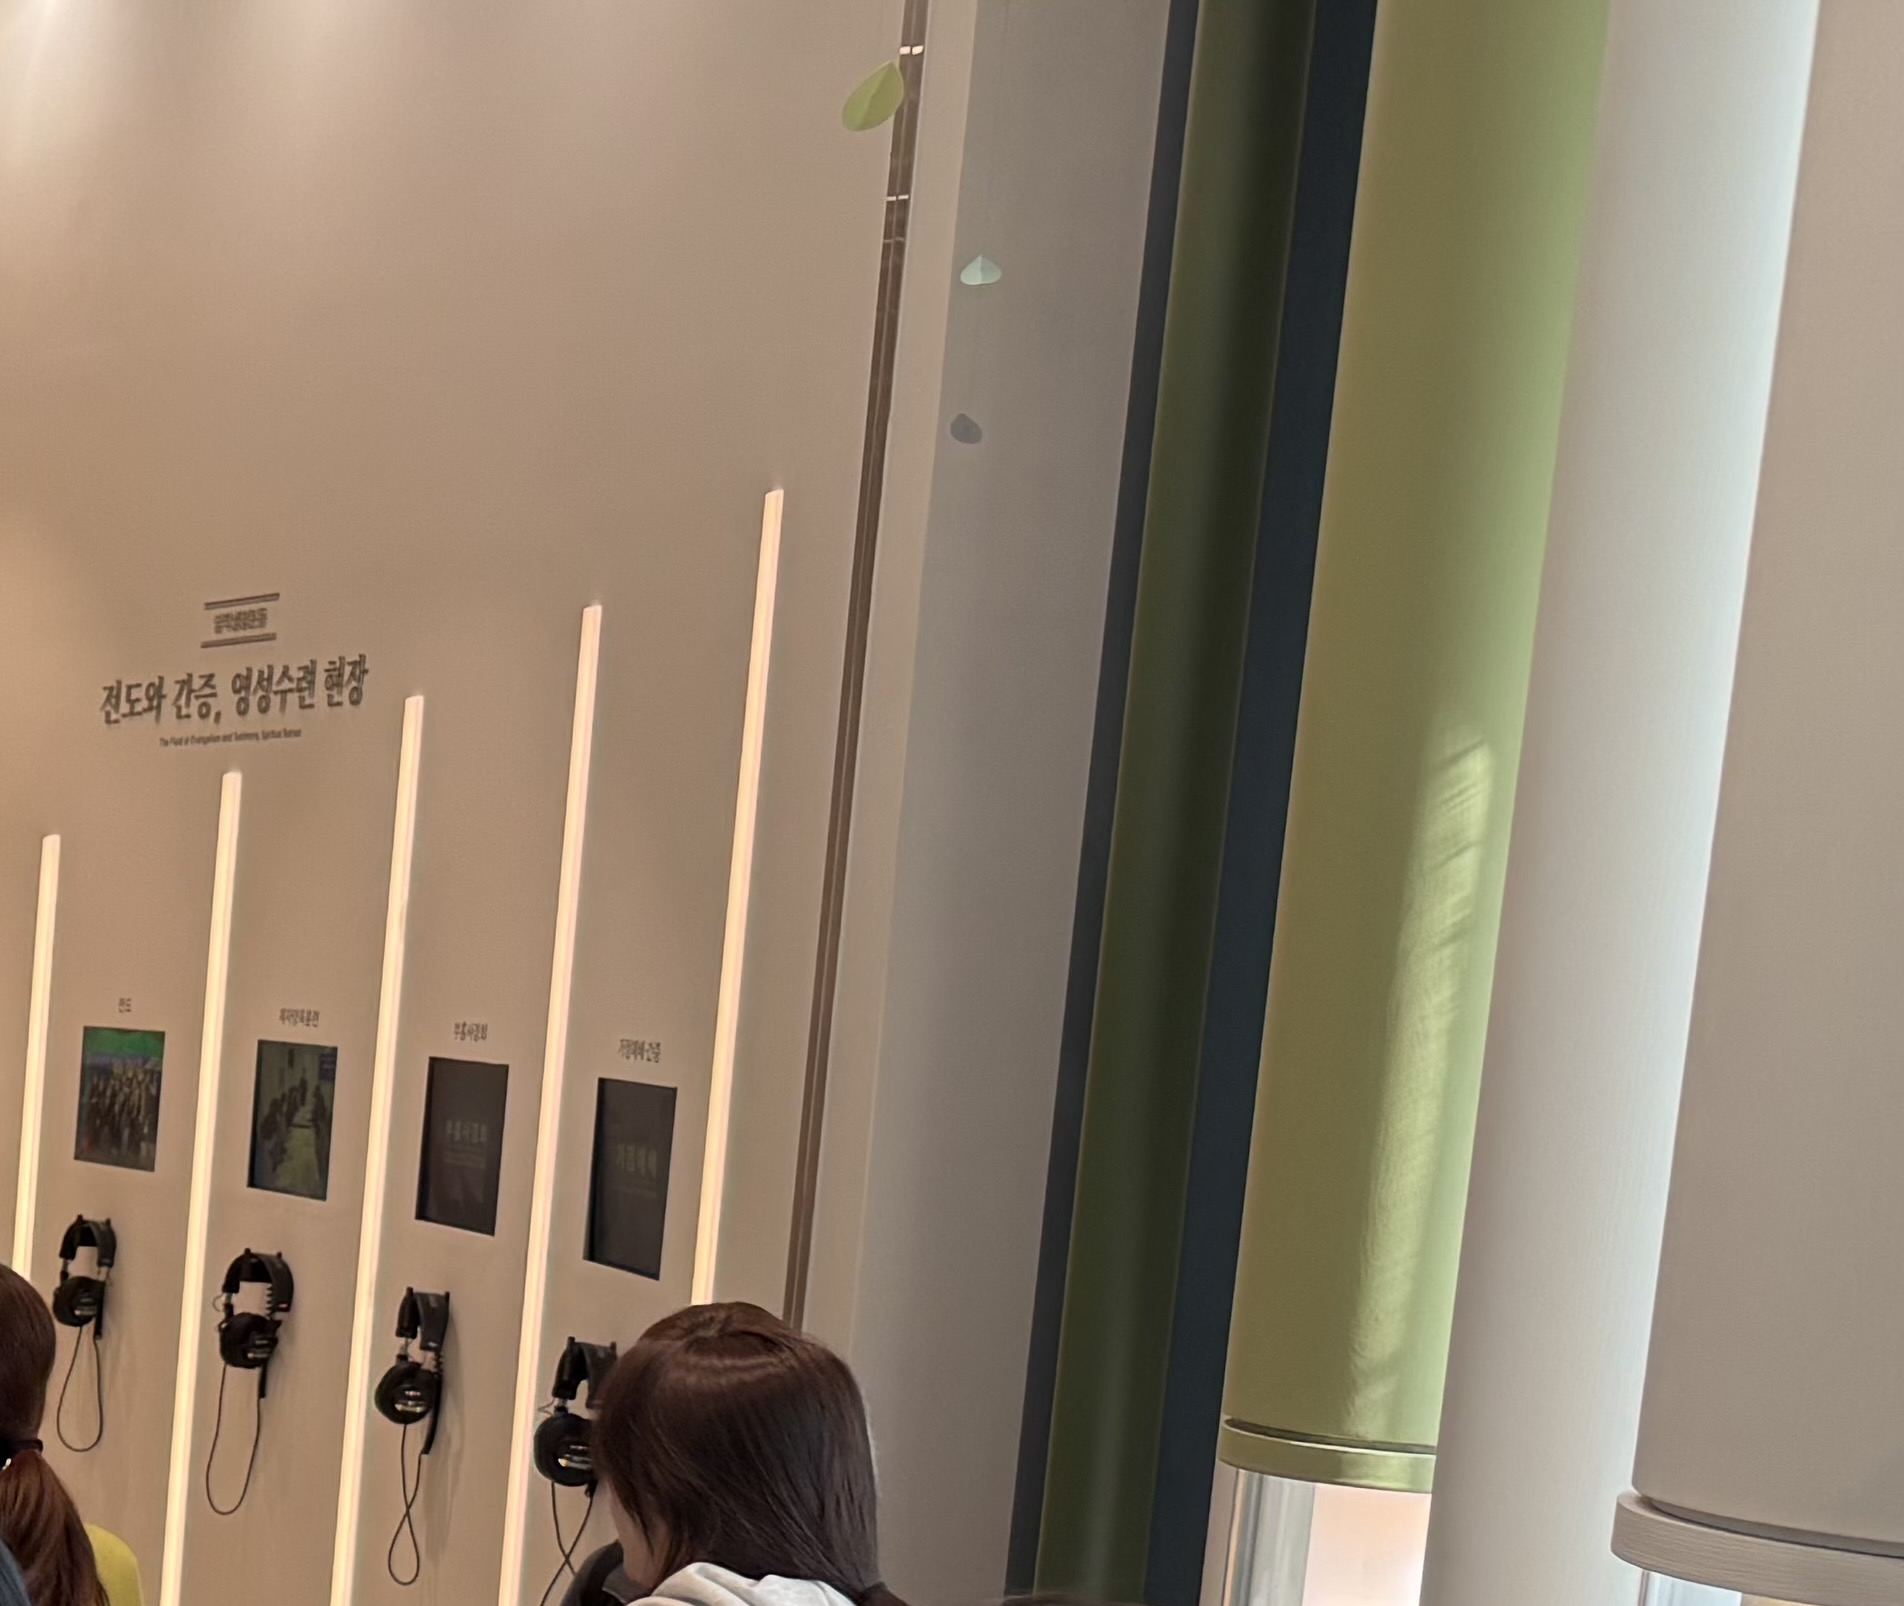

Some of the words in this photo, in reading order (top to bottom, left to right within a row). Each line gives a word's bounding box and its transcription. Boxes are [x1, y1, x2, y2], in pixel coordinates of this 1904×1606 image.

[100, 675, 166, 724] 전도와
[173, 672, 221, 724] 간증,
[230, 658, 317, 716] 영성수련
[323, 653, 369, 708] 현장
